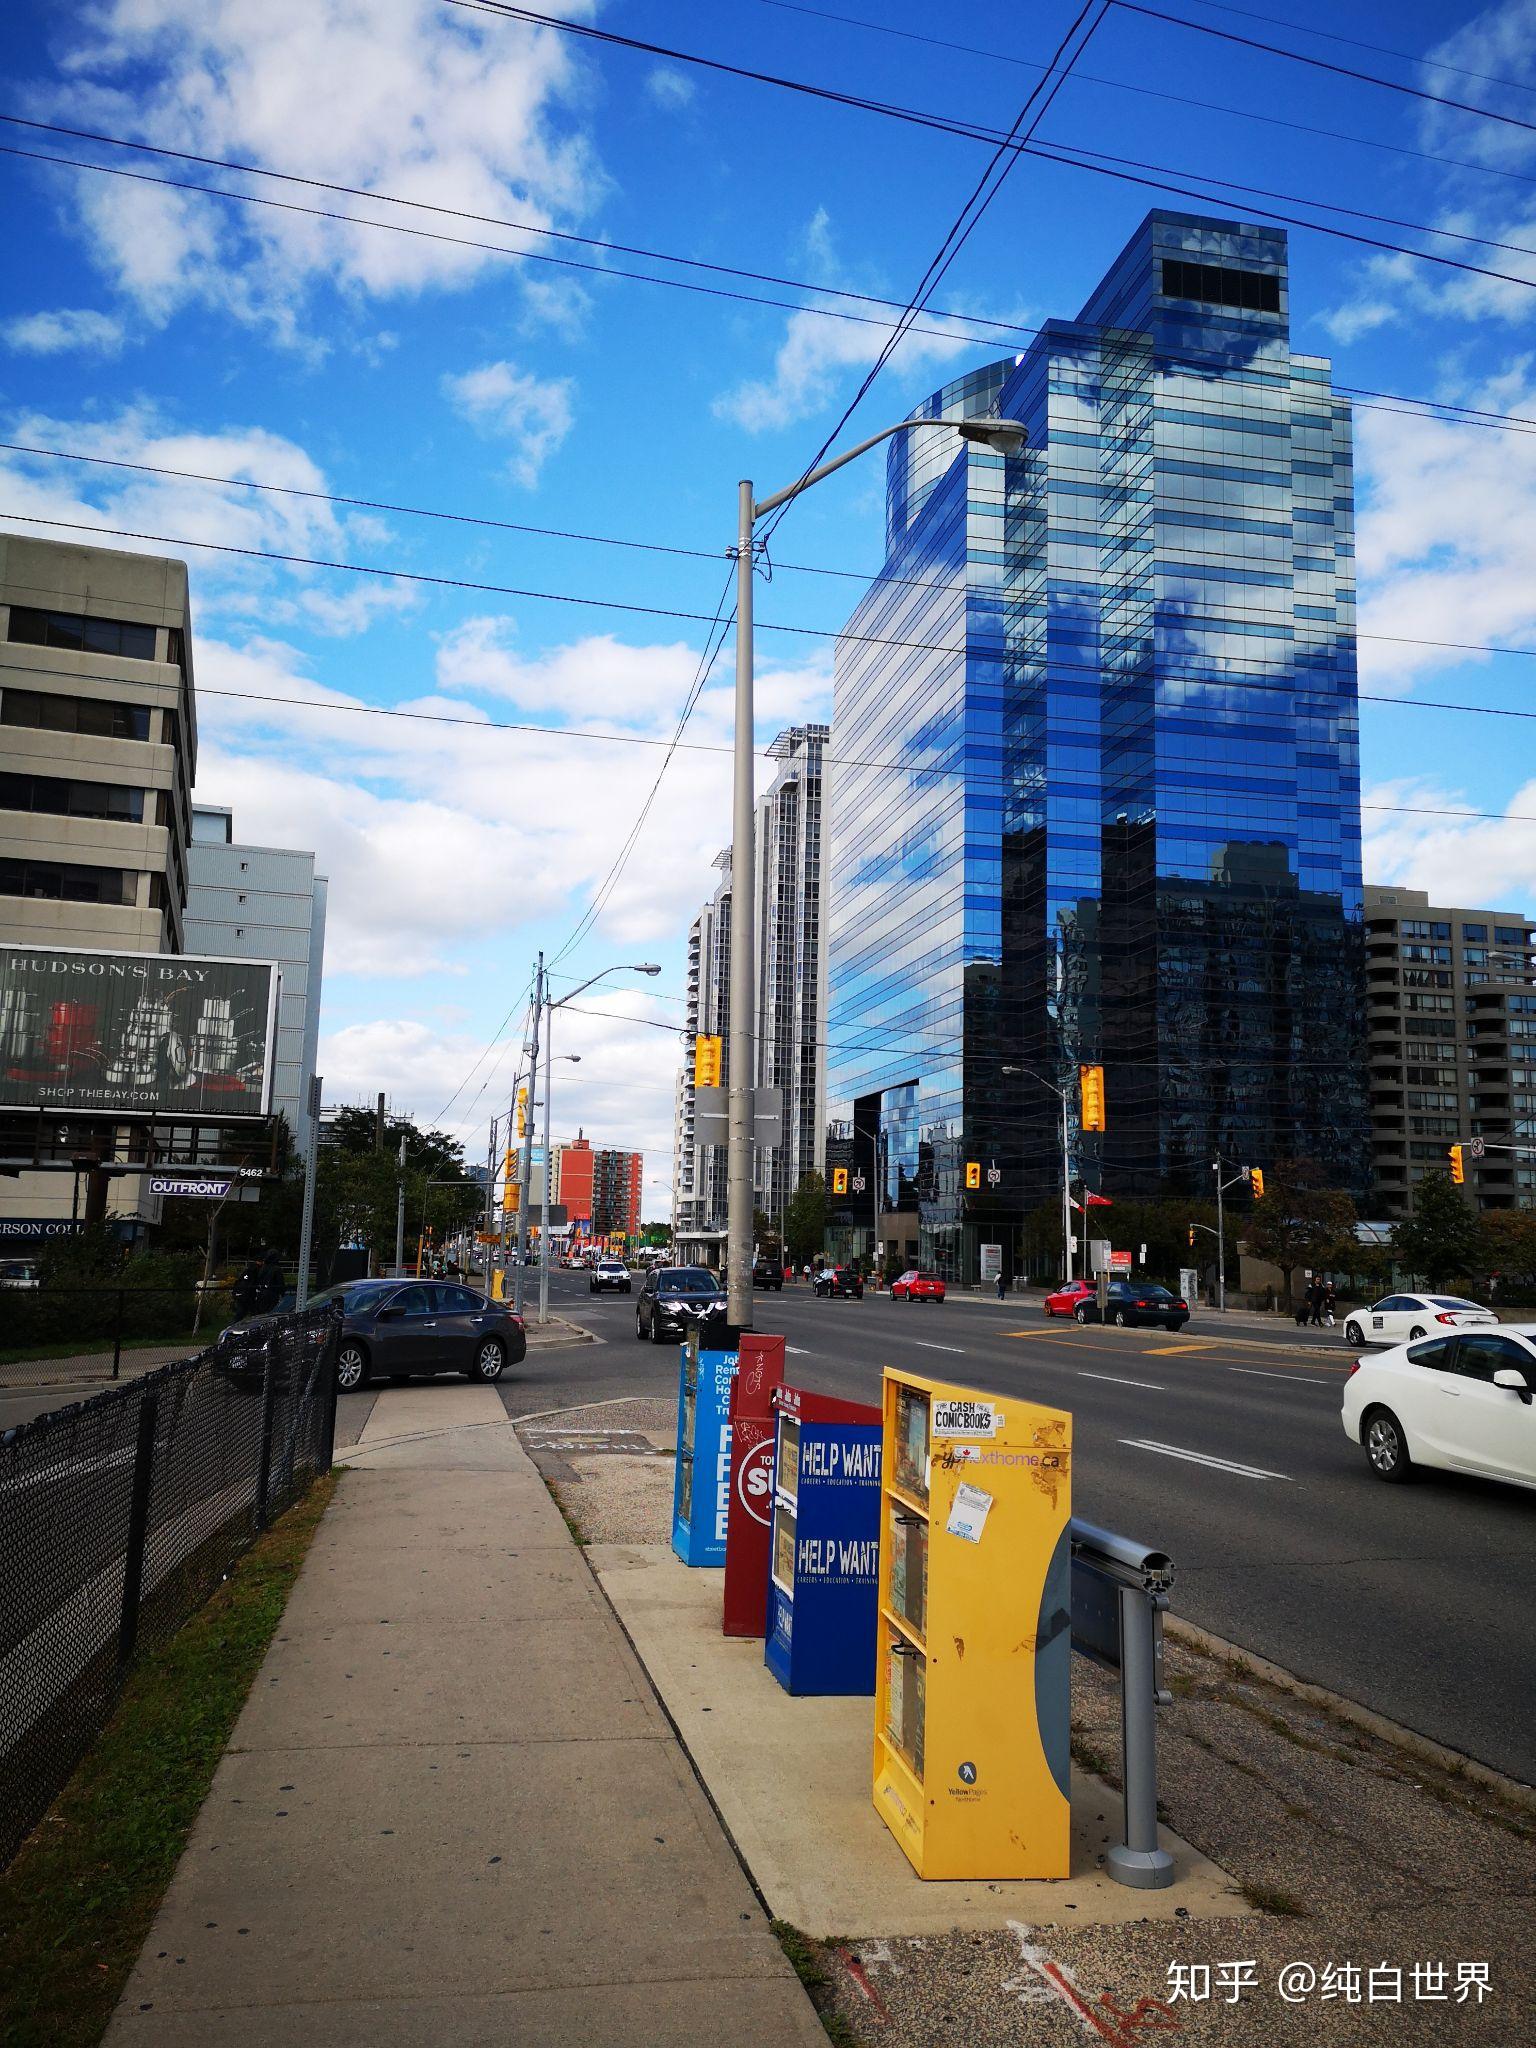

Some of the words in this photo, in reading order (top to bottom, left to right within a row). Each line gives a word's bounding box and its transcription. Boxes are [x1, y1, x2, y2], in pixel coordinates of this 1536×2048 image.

[10, 958, 148, 978] HUDSON'S
[159, 967, 210, 982] BAY
[38, 1087, 75, 1098] SHOP
[78, 1088, 160, 1101] THEBAY.COM
[240, 1167, 263, 1178] 5462
[152, 1181, 226, 1195] OUTFRONT
[949, 1401, 976, 1413] CASH
[801, 1441, 839, 1477] HELP
[842, 1443, 882, 1478] WANT
[798, 1540, 836, 1574] HELP
[838, 1540, 879, 1576] WANT
